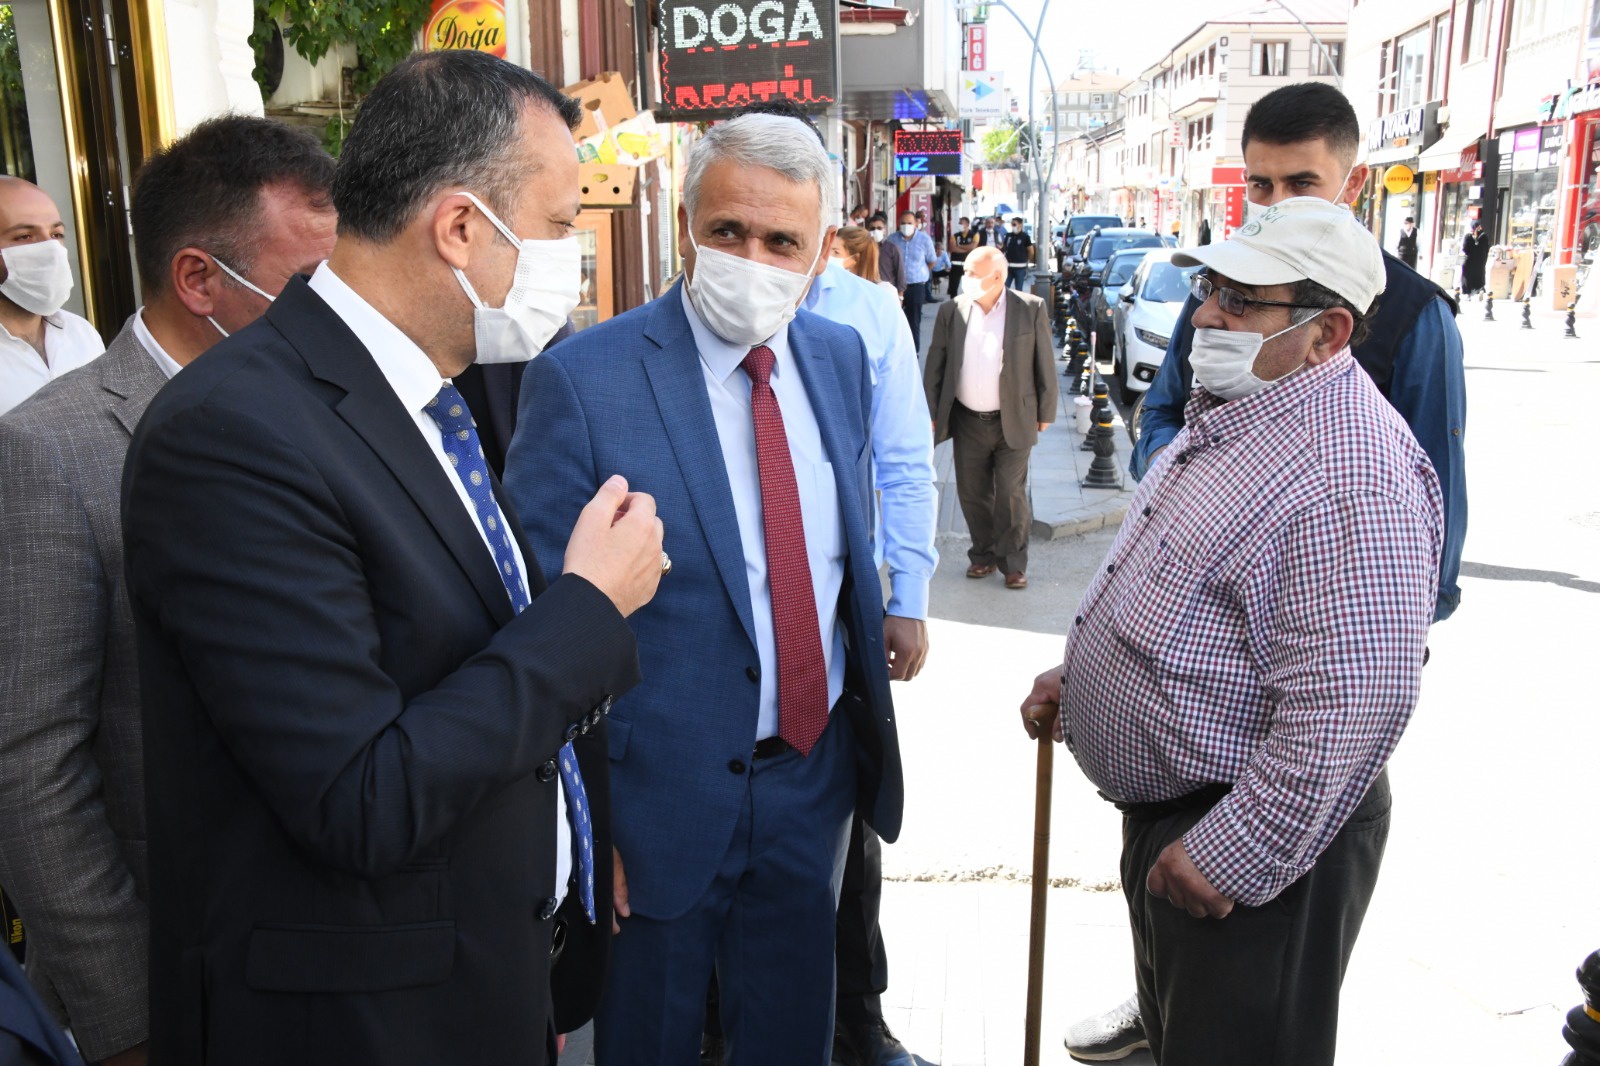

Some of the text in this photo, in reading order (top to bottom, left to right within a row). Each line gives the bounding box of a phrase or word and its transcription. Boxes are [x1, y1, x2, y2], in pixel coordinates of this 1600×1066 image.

[436, 15, 502, 49] Doğa
[1218, 36, 1229, 101] OTEL
[10, 918, 23, 944] Nikon
